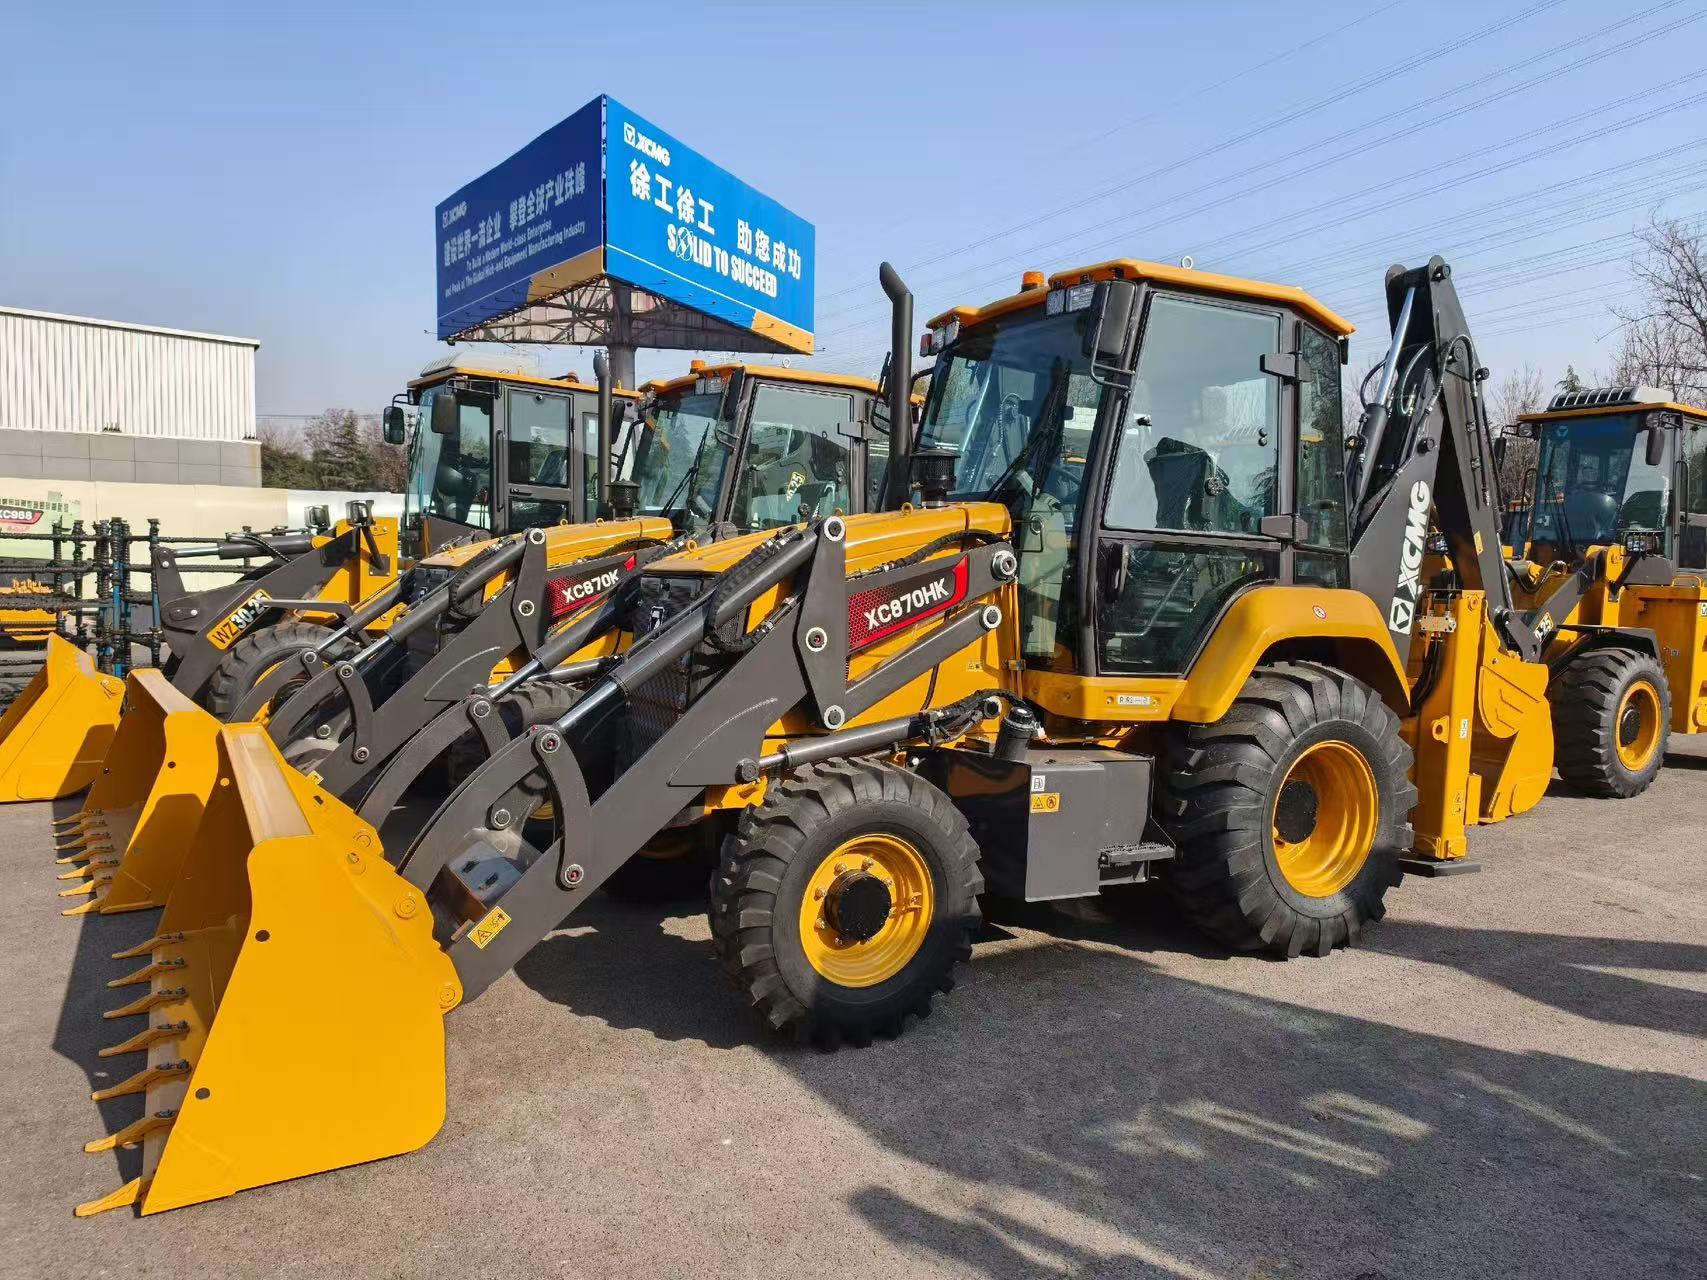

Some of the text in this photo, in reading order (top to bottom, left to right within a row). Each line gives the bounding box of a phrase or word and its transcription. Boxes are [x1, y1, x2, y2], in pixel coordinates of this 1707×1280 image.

[636, 132, 670, 167] XCMG
[527, 219, 552, 241] Enterprise
[528, 232, 563, 257] Manufacturing
[563, 220, 586, 241] Industry
[629, 158, 801, 280] 徐工徐工 助您成功
[713, 246, 728, 276] TO
[731, 255, 777, 298] SUCCEED
[1397, 480, 1430, 600] XCMG
[562, 569, 619, 603] XC870K
[864, 578, 949, 630] XC870HK
